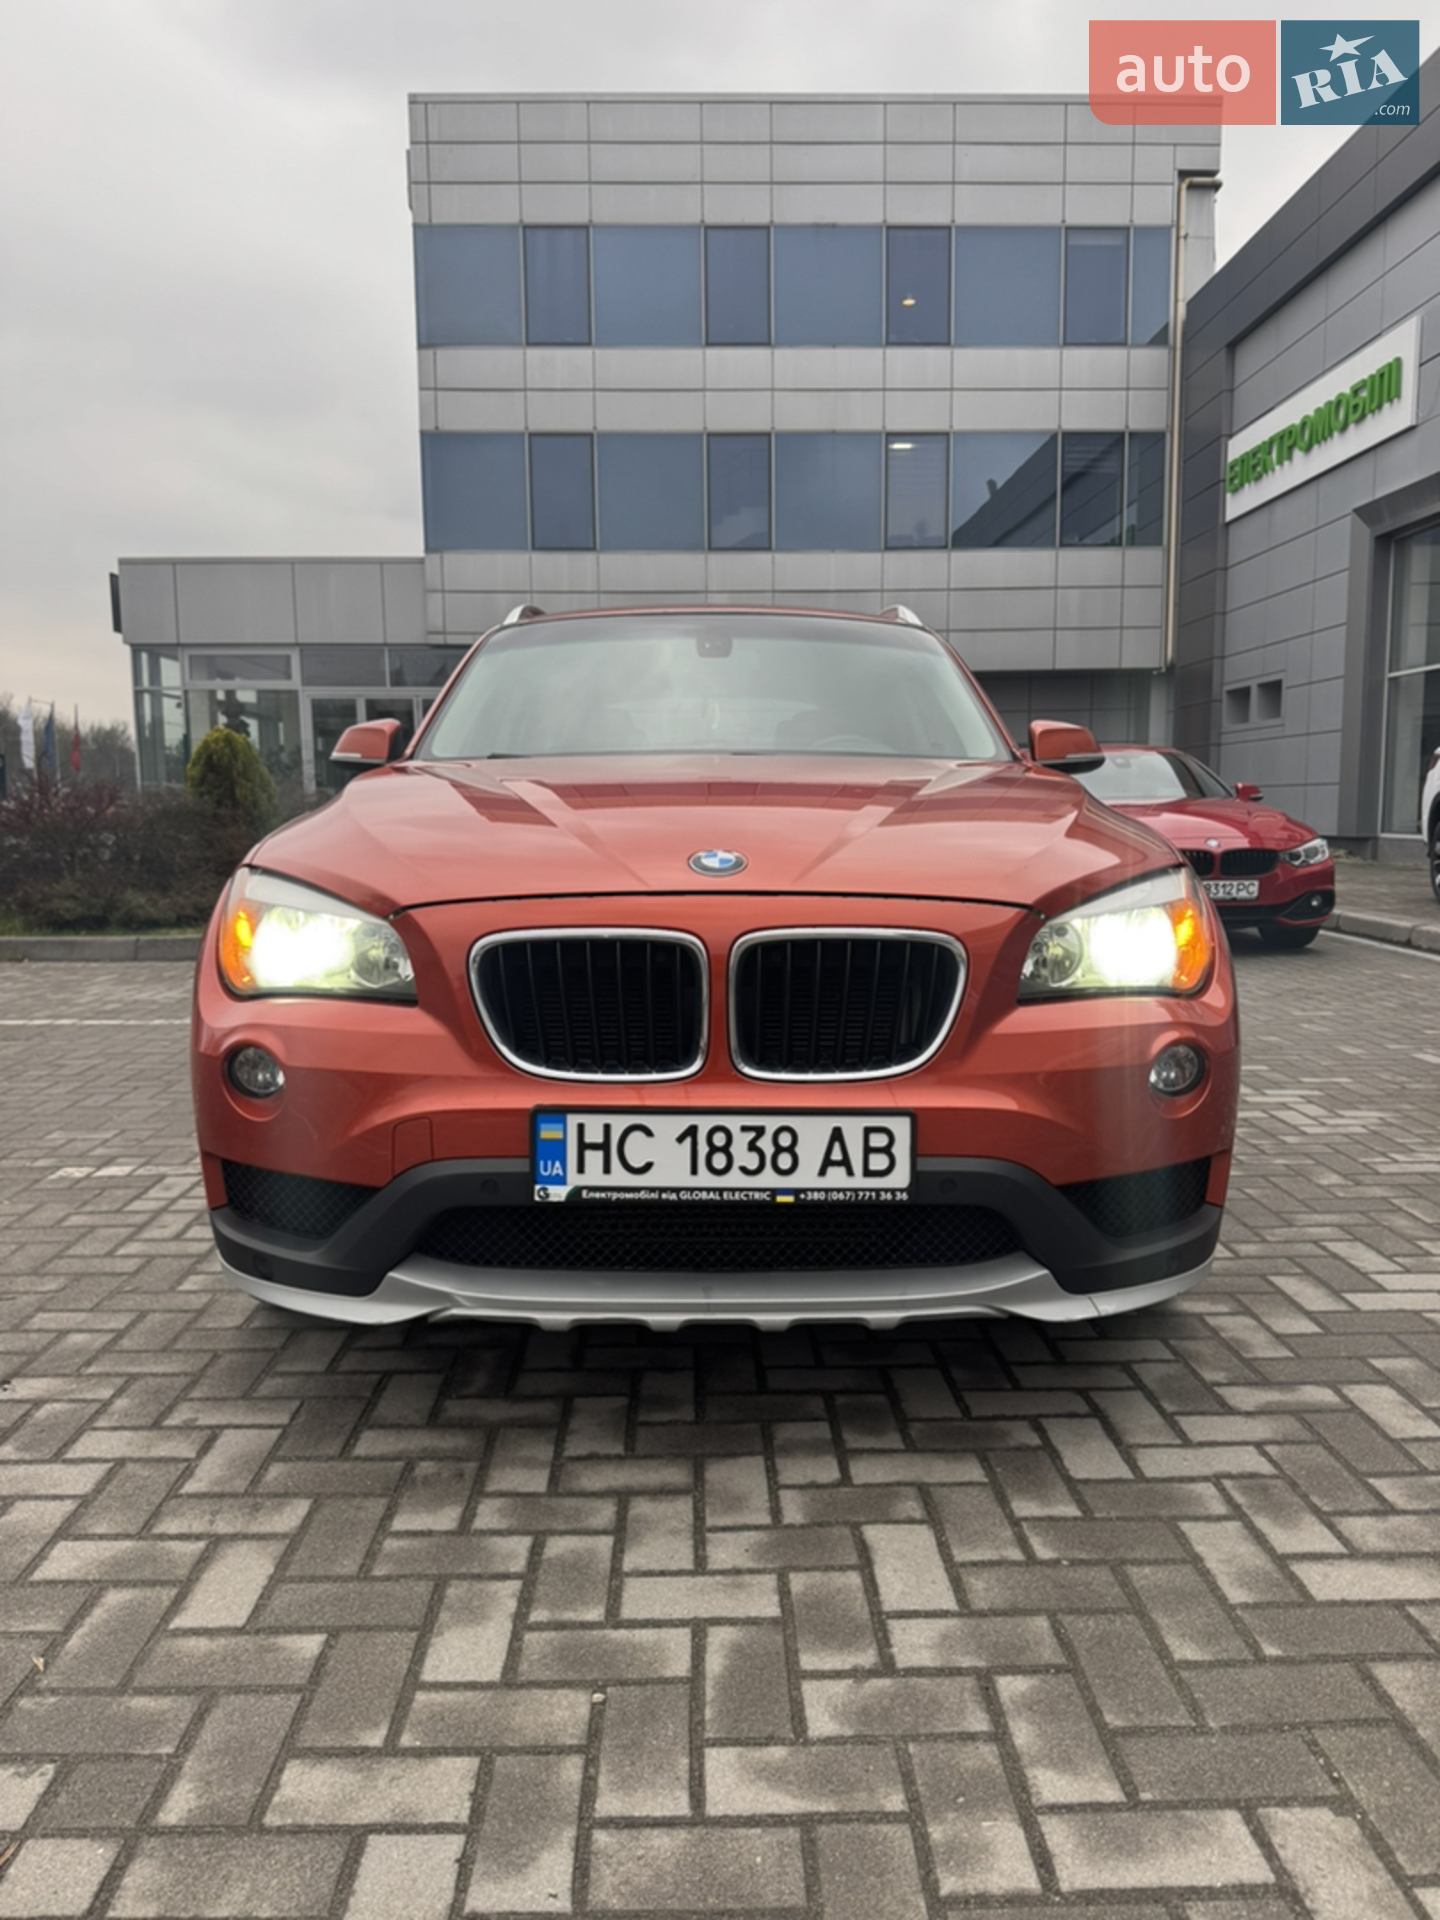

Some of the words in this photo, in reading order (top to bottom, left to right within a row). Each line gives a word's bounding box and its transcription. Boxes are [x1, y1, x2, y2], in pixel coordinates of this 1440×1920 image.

[1226, 356, 1402, 493] ЕЛЕКТРОМОБІЛІ
[577, 1123, 655, 1175] HC
[675, 1124, 800, 1177] 1838
[817, 1126, 896, 1178] AB
[540, 1160, 563, 1176] UA
[581, 1188, 659, 1200] Електромобілі
[661, 1190, 678, 1201] від
[680, 1190, 720, 1201] GLOBAL
[723, 1190, 771, 1201] ELECTRIC
[799, 1191, 825, 1200] +380
[828, 1191, 855, 1202] (067)
[857, 1191, 876, 1200] 771
[879, 1191, 892, 1200] 36
[895, 1191, 908, 1200] 36
